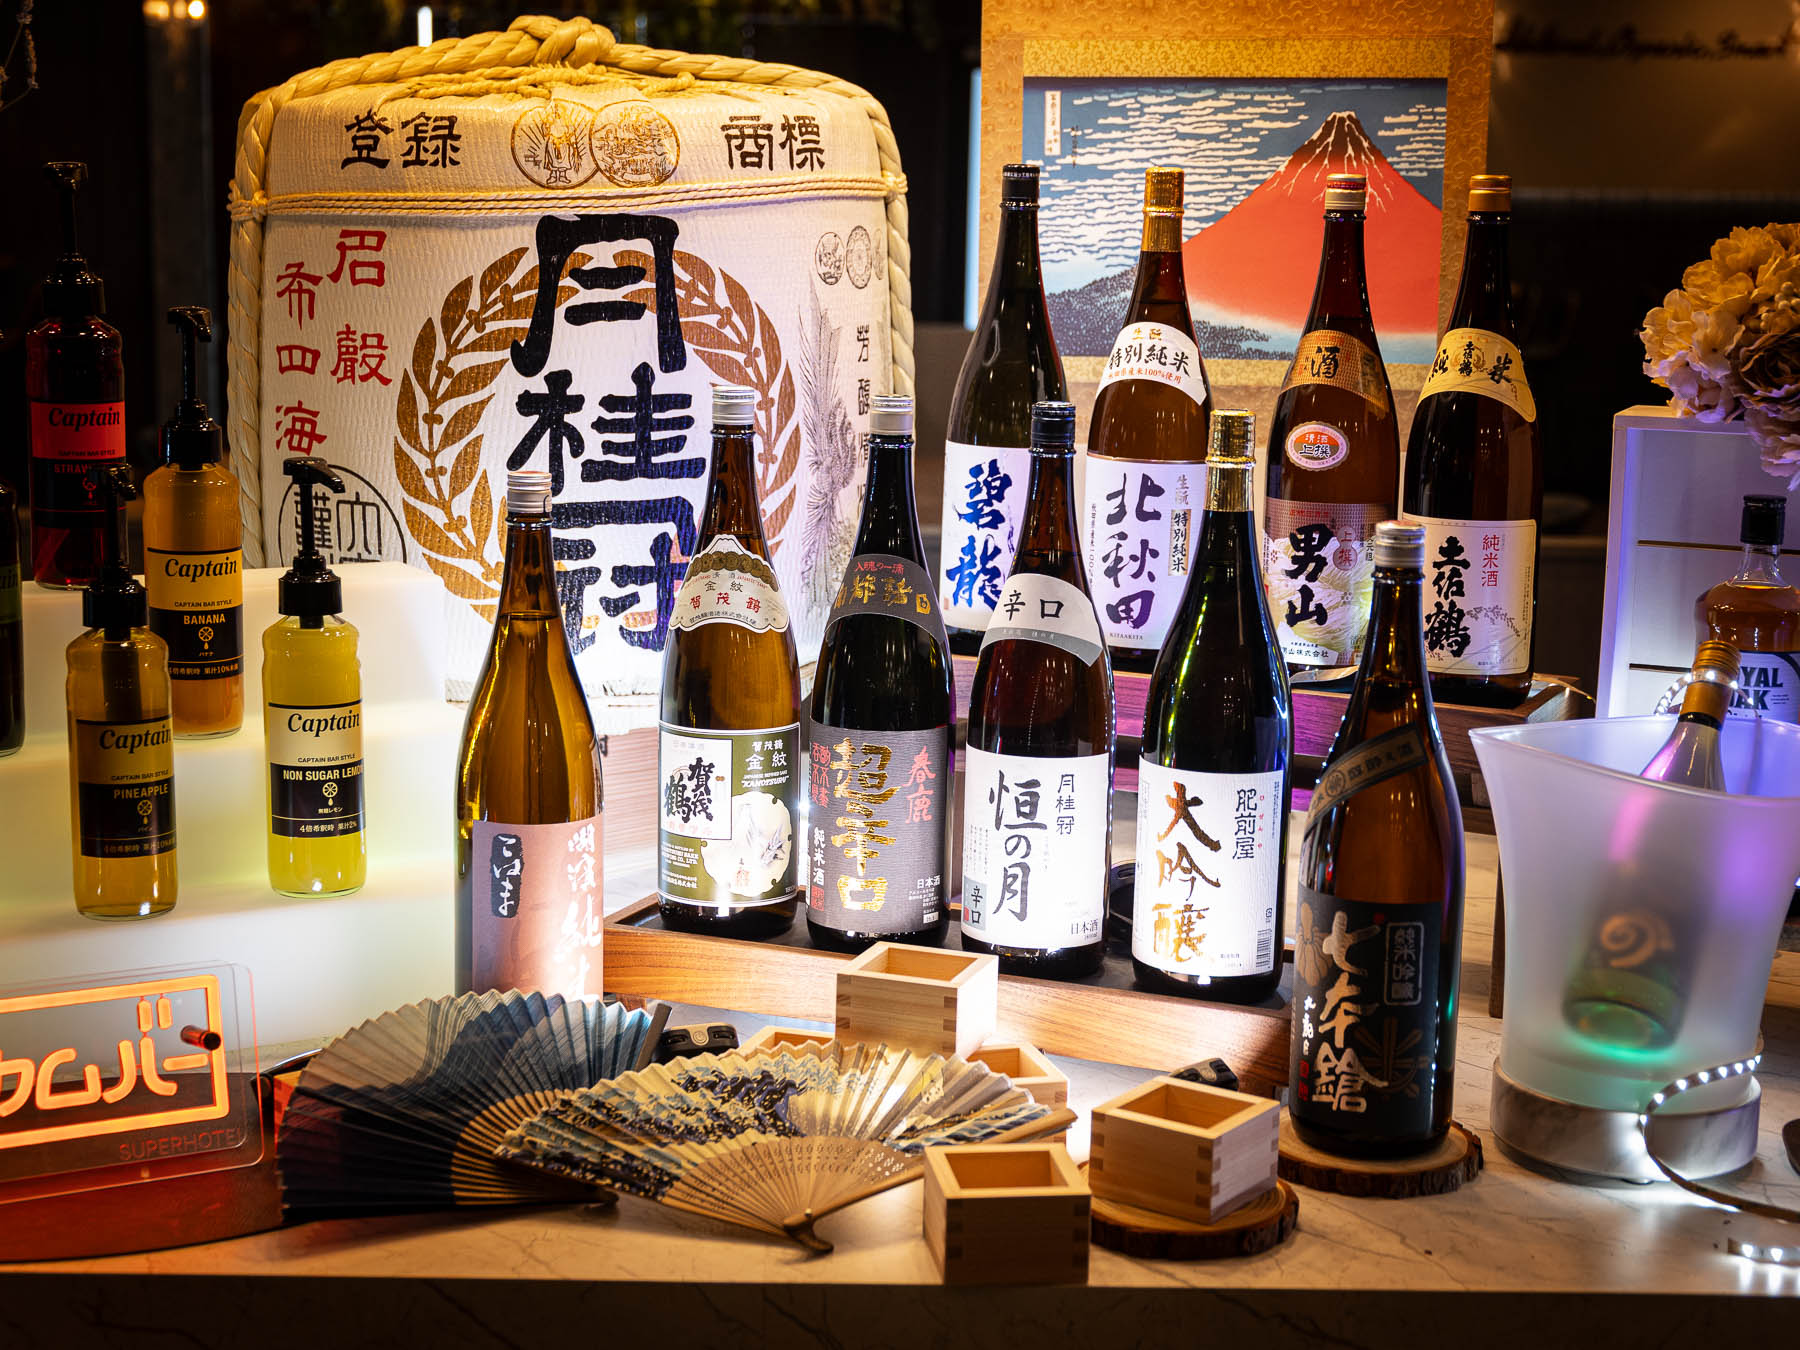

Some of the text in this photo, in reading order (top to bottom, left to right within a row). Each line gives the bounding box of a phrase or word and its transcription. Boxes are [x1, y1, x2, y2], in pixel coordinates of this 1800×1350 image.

[340, 108, 826, 171] 登録 商標
[1109, 343, 1191, 377] 特別純米
[1311, 346, 1340, 378] 酒
[49, 407, 120, 432] Captain
[507, 213, 707, 655] 月桂冠
[1299, 444, 1330, 457] 上撰
[1102, 473, 1166, 629] 北秋田
[1171, 511, 1189, 573] 特別純米
[165, 556, 237, 582] Captain
[1284, 523, 1334, 627] 男山
[1481, 534, 1501, 587] 純米酒
[704, 580, 744, 592] 金紋
[1424, 535, 1472, 658] 土佐鶴
[183, 613, 226, 625] BANANA
[689, 592, 762, 614] 賀茂鶴
[1003, 589, 1064, 621] 辛口
[1109, 632, 1144, 641] KITAAKITA
[100, 724, 172, 754] Captain
[287, 709, 360, 738] Captain
[283, 765, 365, 781] NON SUGAR LEMO
[297, 756, 326, 764] CAPTAIN
[341, 753, 356, 761] STYLE
[745, 751, 787, 771] 金紋
[113, 783, 169, 800] PINEAPPLE
[902, 746, 937, 824] 春鹿
[1055, 773, 1076, 835] 月桂冠
[830, 737, 900, 912] 超辛口
[1232, 788, 1258, 860] 肥前屋
[812, 827, 826, 886] 純米酒
[989, 769, 1048, 922] 恒の月
[916, 875, 940, 890] 日本酒
[970, 885, 984, 924] 辛口
[1071, 920, 1099, 935] 日本酒
